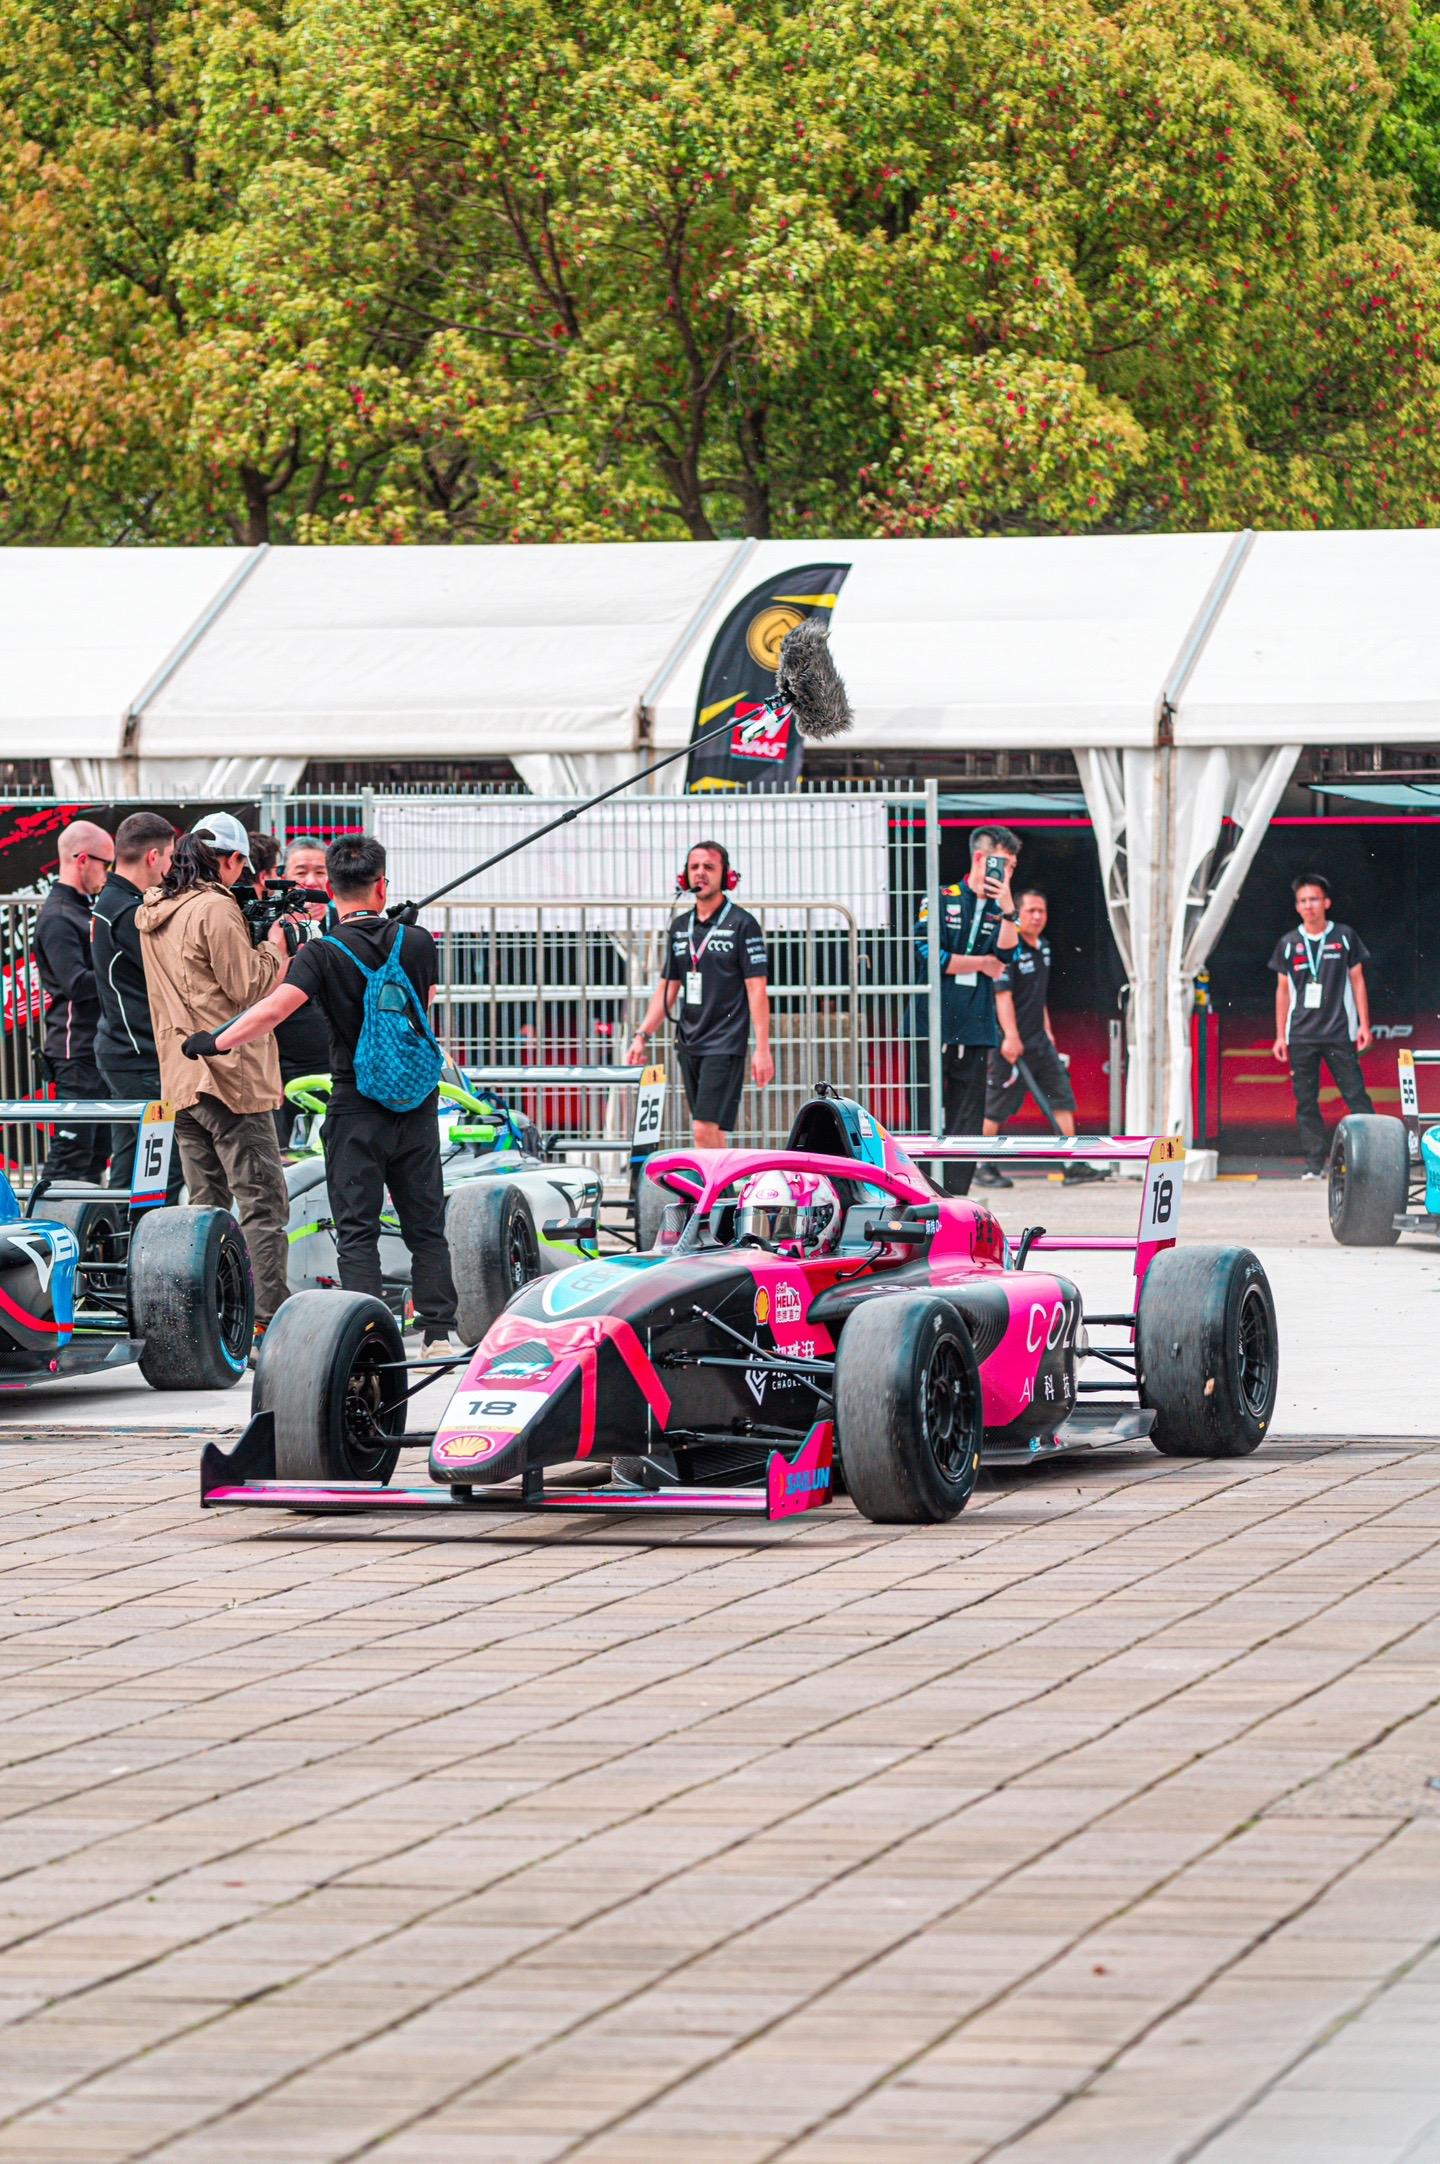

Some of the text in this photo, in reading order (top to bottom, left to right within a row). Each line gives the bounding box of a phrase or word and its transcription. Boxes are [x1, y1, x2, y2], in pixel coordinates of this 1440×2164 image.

[638, 1098, 660, 1132] 26
[144, 1138, 164, 1177] 15
[1152, 1180, 1173, 1224] 18
[776, 1294, 800, 1309] HELIX
[1019, 1376, 1035, 1403] AI
[468, 1400, 517, 1416] 18
